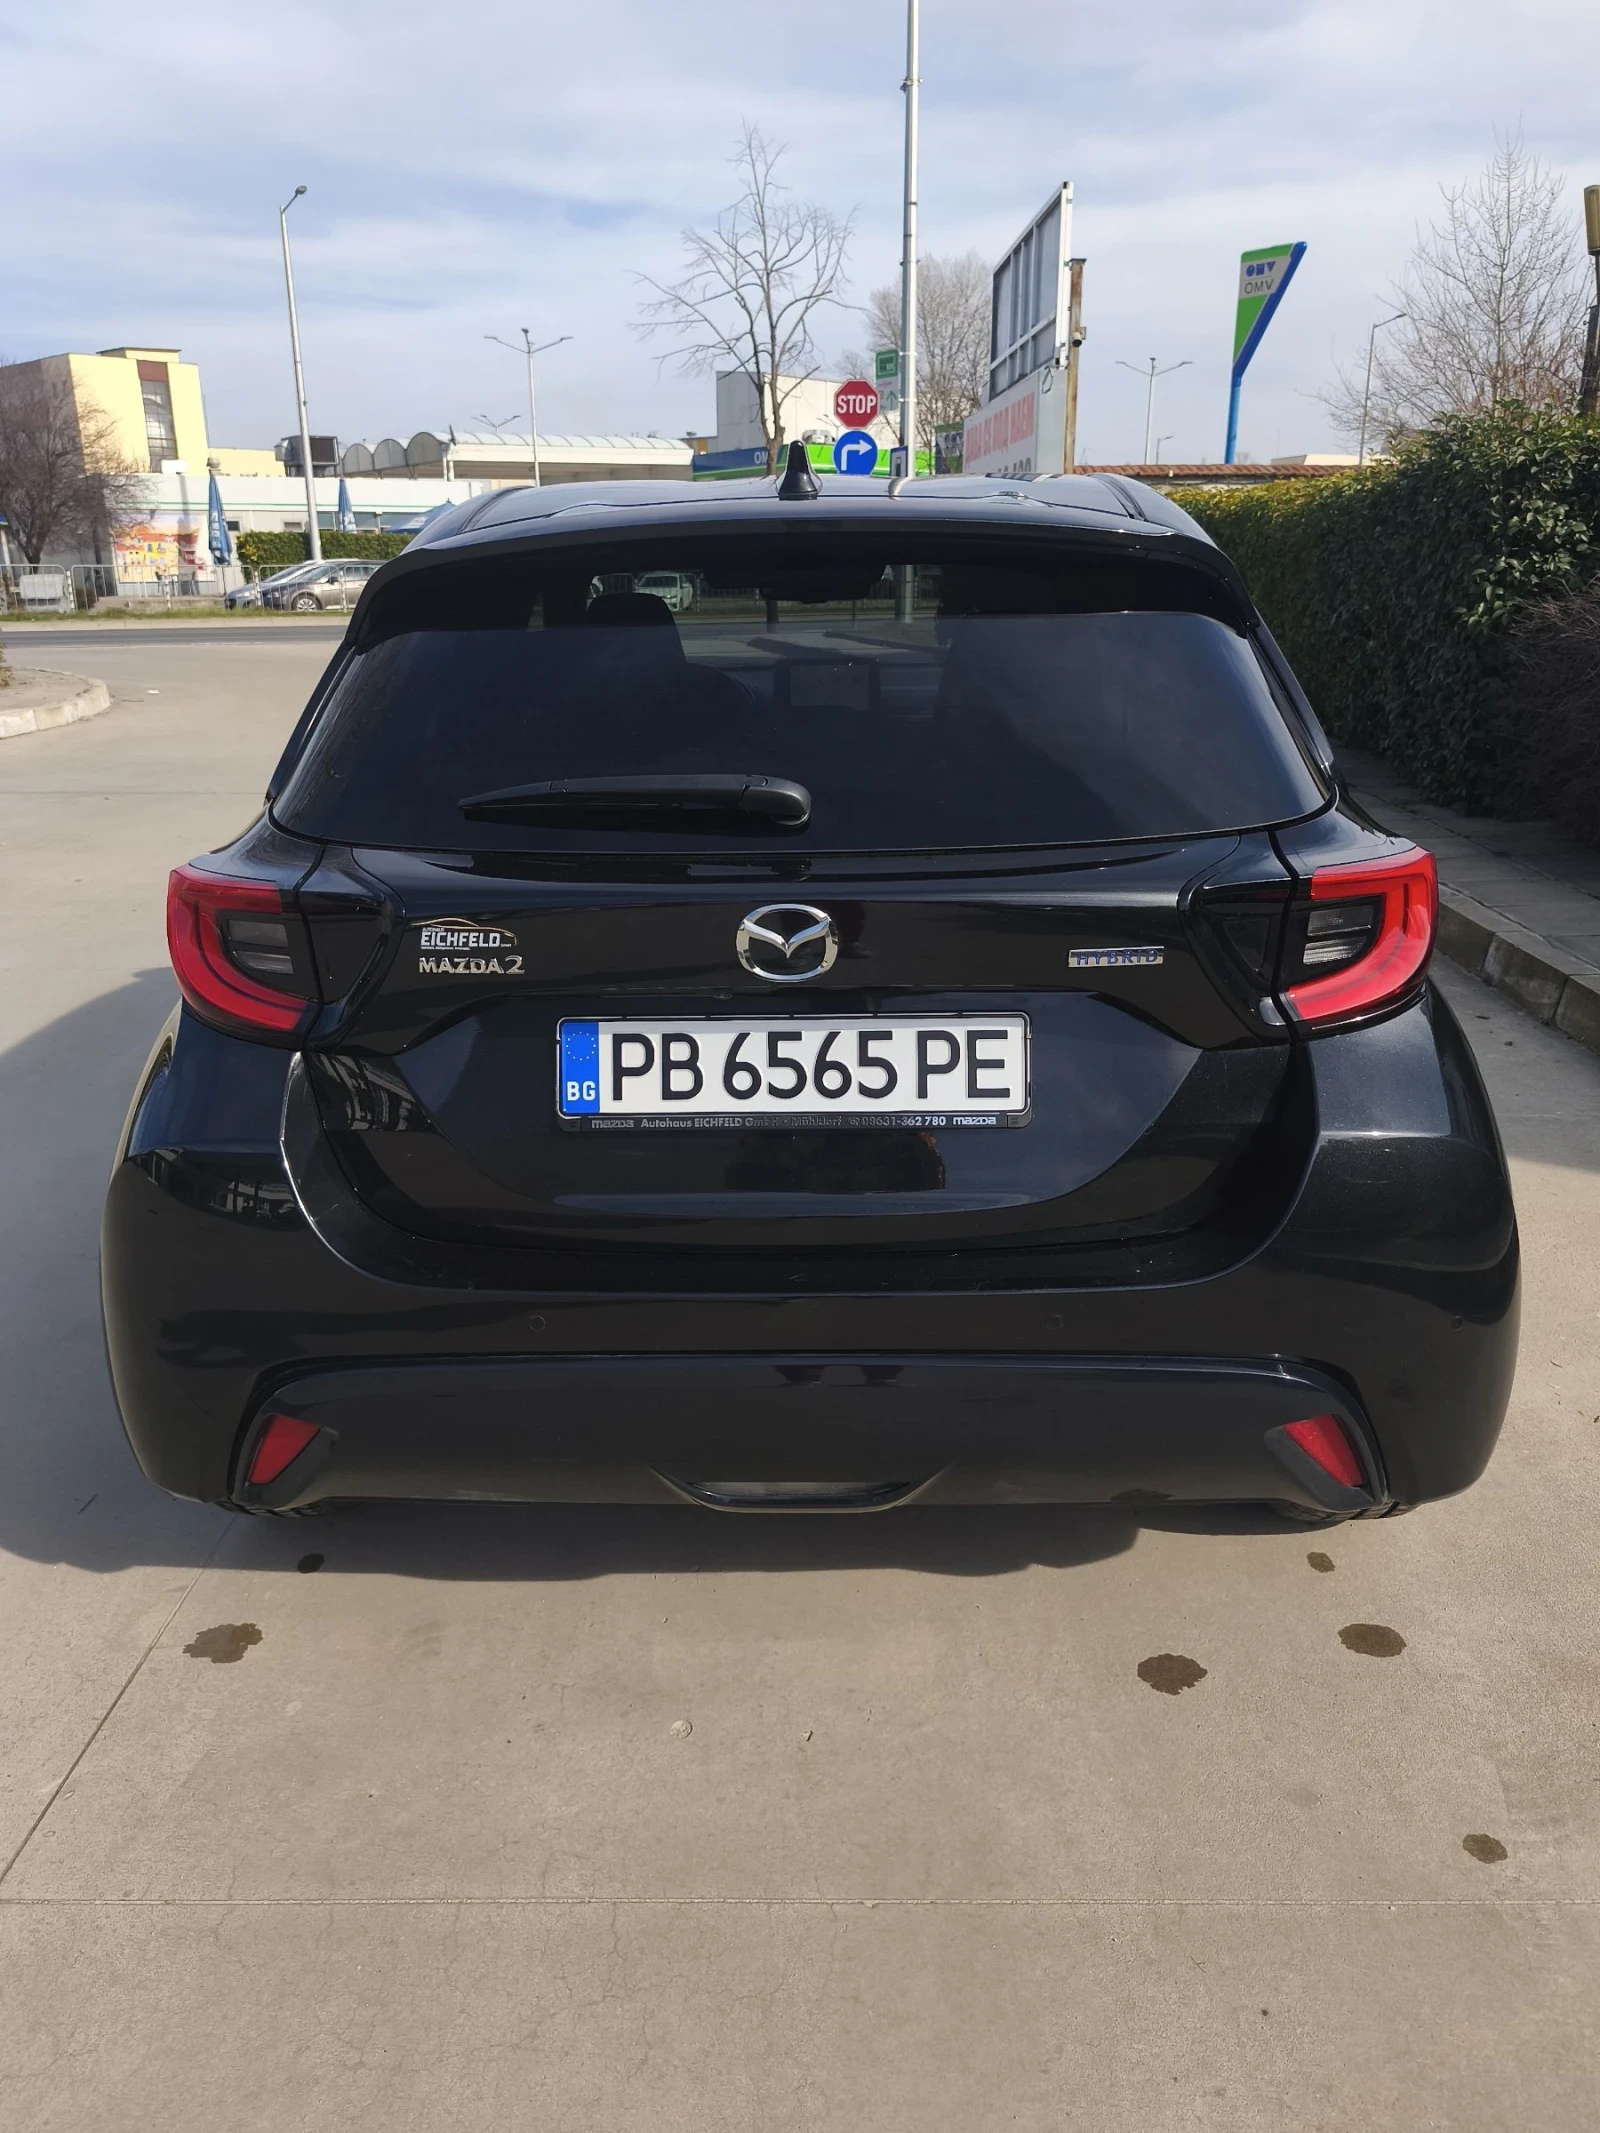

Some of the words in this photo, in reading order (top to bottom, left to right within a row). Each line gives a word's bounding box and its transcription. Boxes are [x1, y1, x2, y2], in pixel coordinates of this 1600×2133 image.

[1245, 260, 1276, 277] OMV
[1244, 279, 1275, 294] OMV
[837, 394, 877, 414] STOP
[421, 932, 501, 947] EICHFELD
[1076, 948, 1159, 965] HYBRID
[612, 1032, 703, 1100] PB
[723, 1031, 898, 1099] 6565
[917, 1029, 1010, 1098] PE
[567, 1081, 596, 1101] BG
[591, 1118, 634, 1128] mazda
[640, 1117, 692, 1128] Autohaus
[694, 1117, 742, 1127] EICHFELD
[953, 1116, 996, 1125] mazda
